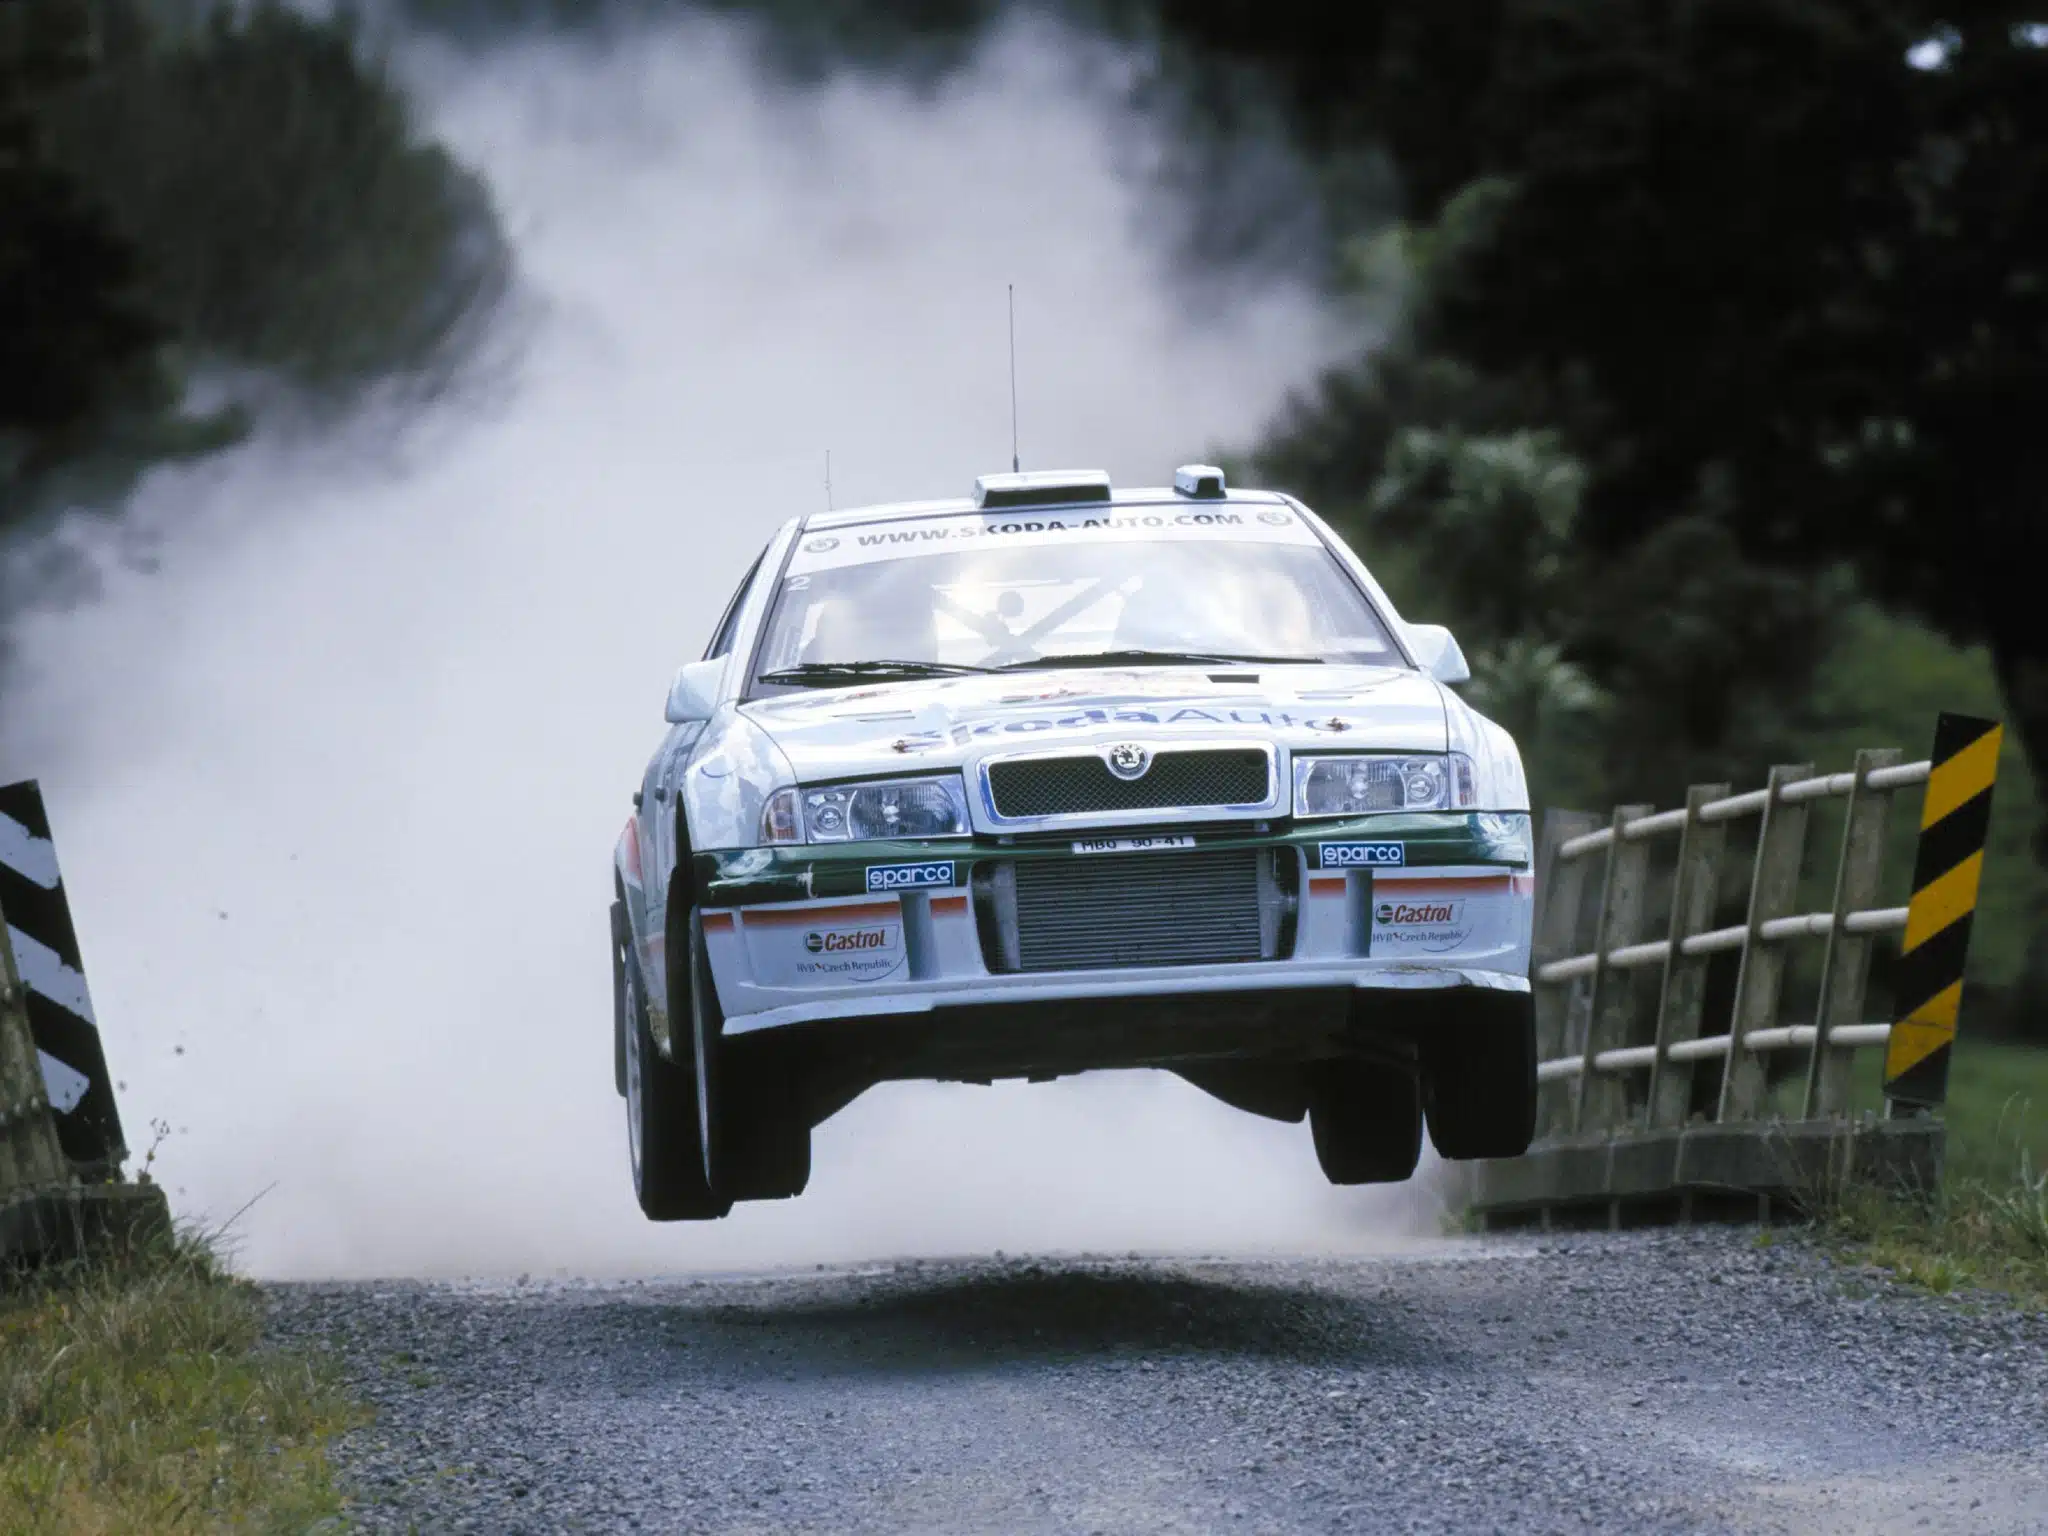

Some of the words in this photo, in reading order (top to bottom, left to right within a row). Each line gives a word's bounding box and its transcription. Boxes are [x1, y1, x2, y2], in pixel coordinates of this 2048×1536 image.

[1324, 846, 1401, 866] sparco
[870, 866, 951, 890] sparco
[1394, 904, 1453, 924] Castrol
[825, 929, 886, 952] Castrol
[1400, 931, 1428, 942] Czech
[1428, 929, 1464, 943] Republic
[822, 960, 851, 973] Czech
[851, 958, 893, 972] Republic
